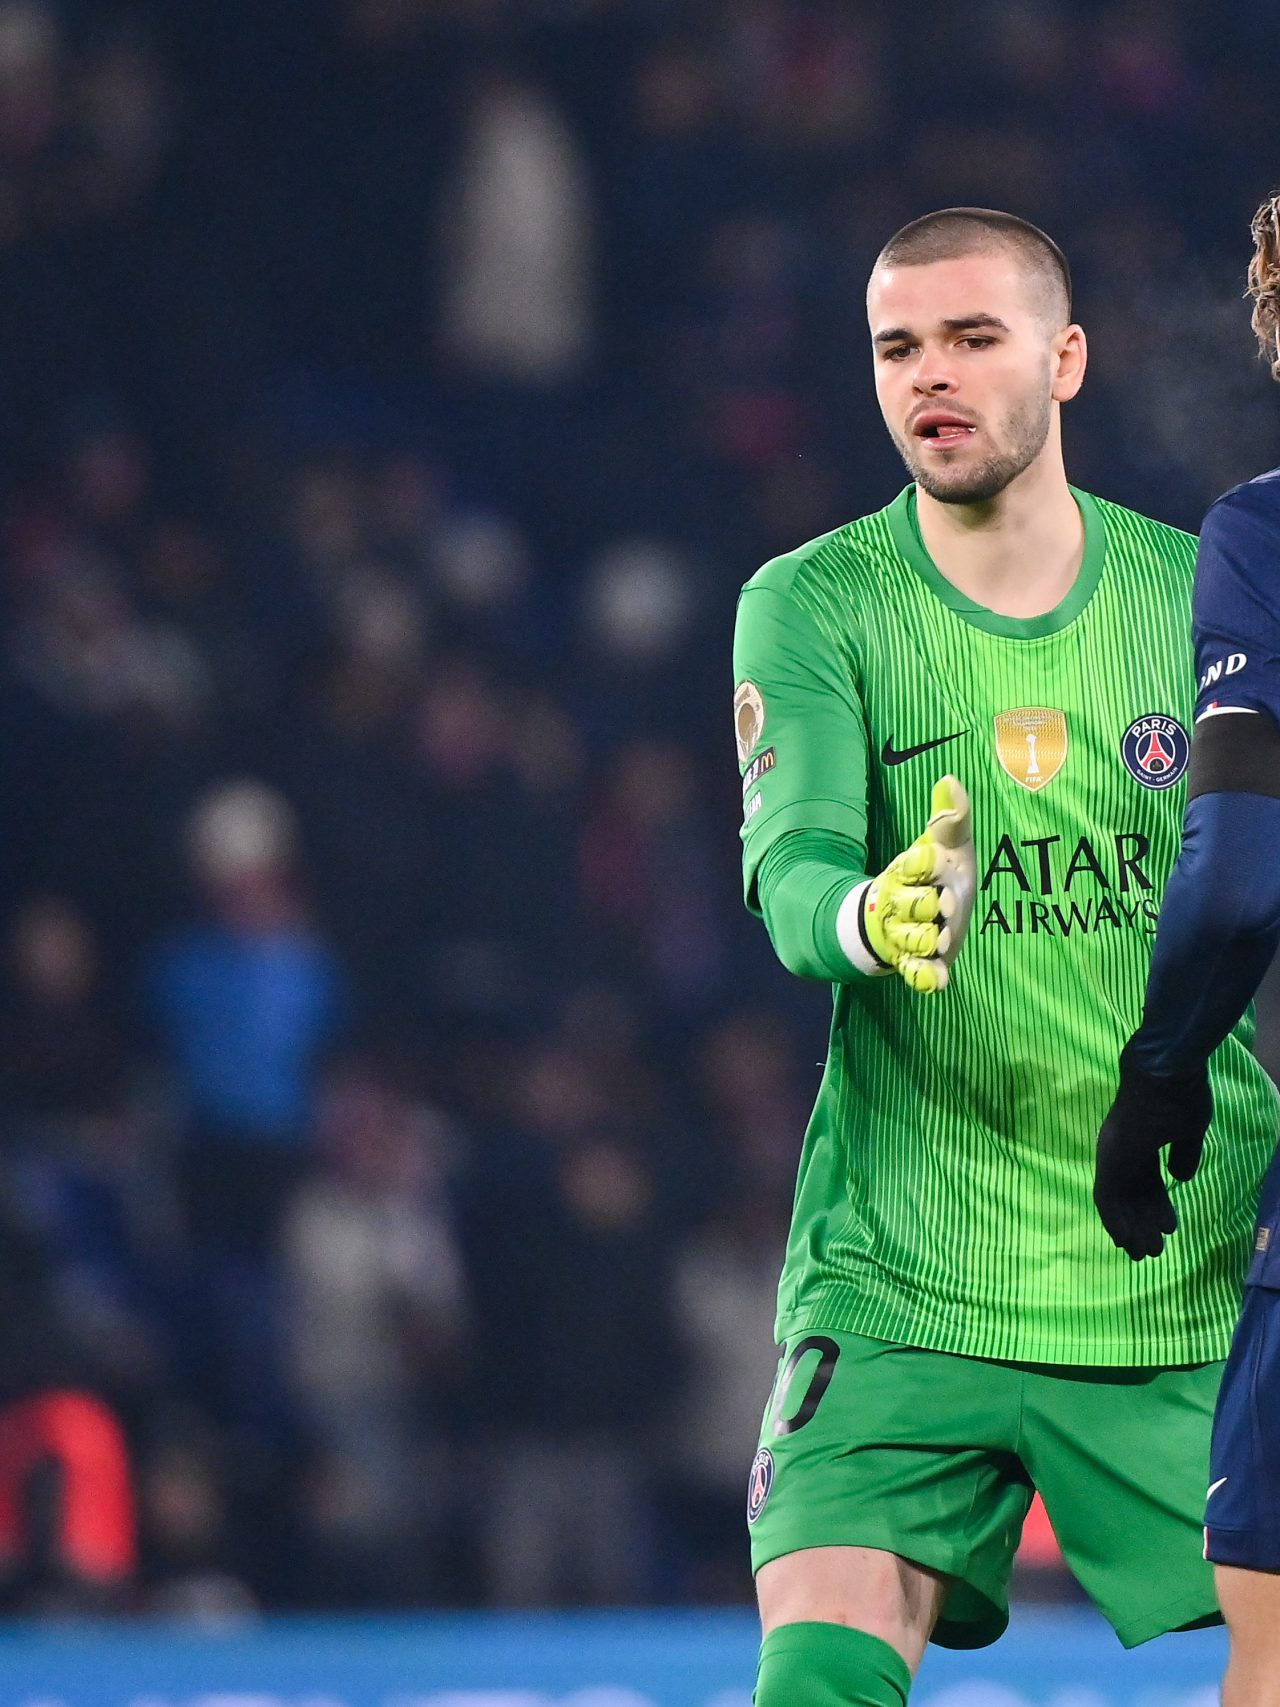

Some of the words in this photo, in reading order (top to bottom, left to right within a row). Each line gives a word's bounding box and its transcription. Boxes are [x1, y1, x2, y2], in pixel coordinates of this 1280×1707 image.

[1198, 653, 1247, 695] ND
[1131, 718, 1177, 738] PARIS
[1136, 768, 1152, 782] SAINT
[980, 833, 1153, 895] ATAR
[980, 895, 1158, 937] AIRWAYS
[772, 1335, 841, 1436] 0
